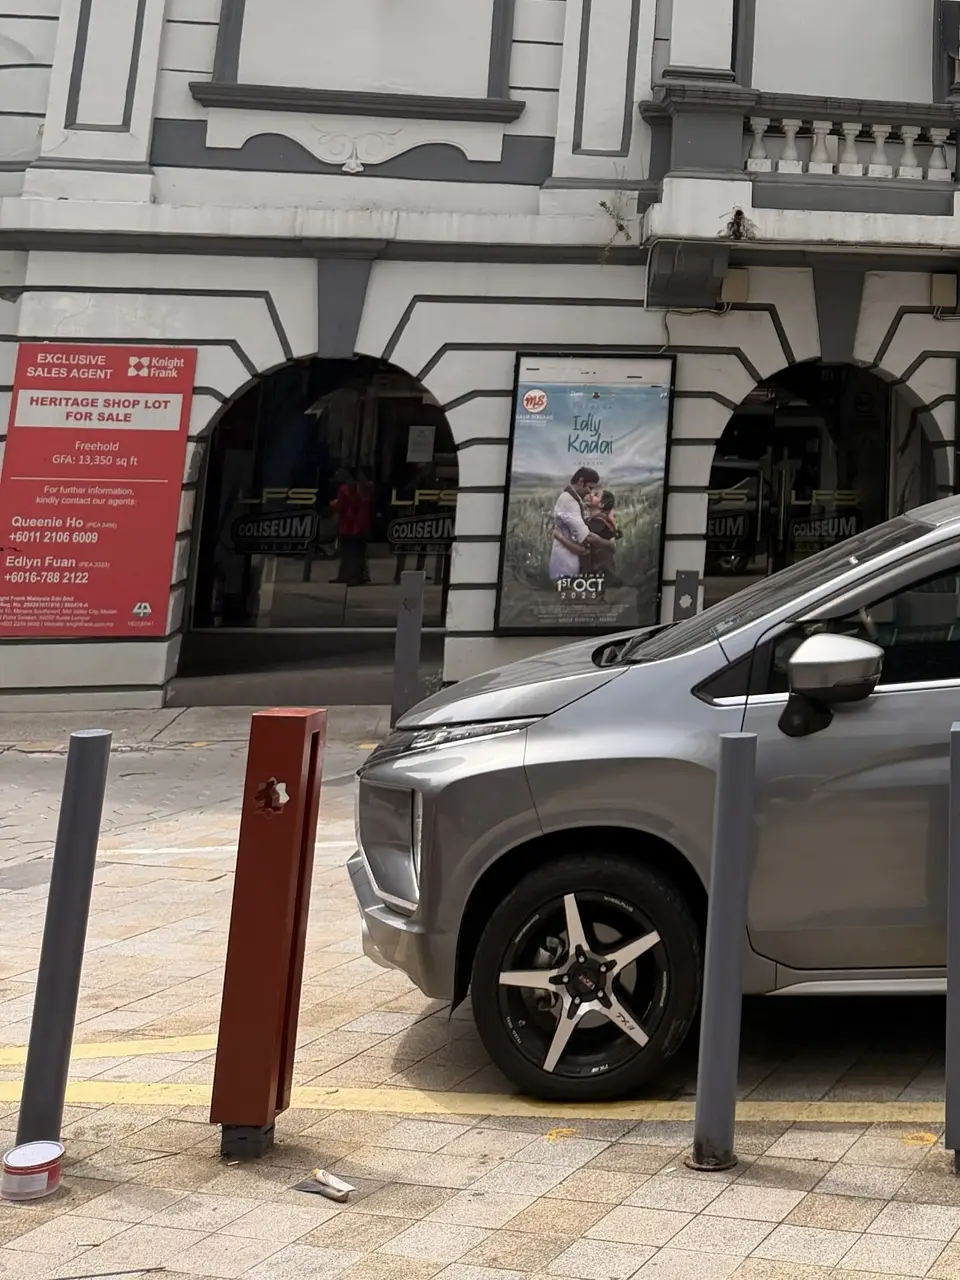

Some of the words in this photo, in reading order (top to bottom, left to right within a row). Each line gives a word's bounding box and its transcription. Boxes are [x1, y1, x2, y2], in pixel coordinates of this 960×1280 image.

[37, 353, 107, 366] EXCLUSIVE
[151, 356, 185, 369] Knight
[27, 367, 68, 379] SALES
[70, 368, 114, 380] AGENT
[150, 368, 178, 378] Frank
[29, 396, 99, 408] HERITAGE
[103, 398, 141, 409] SHOP
[144, 399, 170, 410] LOT
[65, 411, 93, 422] FOR
[97, 412, 133, 423] SALE
[572, 412, 601, 437] Idly
[75, 440, 120, 452] Freehold
[567, 432, 614, 455] Kadai
[52, 454, 77, 465] GFA:
[79, 454, 113, 466] 13,350
[116, 457, 128, 468] sq
[128, 456, 139, 466] ft
[44, 486, 59, 494] For
[60, 486, 86, 494] further
[36, 496, 60, 505] kindly
[61, 497, 91, 505] contact
[791, 489, 860, 506] LFS
[11, 516, 63, 528] Queenie
[66, 517, 84, 528] Ho
[238, 515, 313, 538] COLISEUM
[793, 516, 857, 537] COLISEUM
[9, 531, 41, 543] +6011
[43, 531, 70, 543] 2106
[72, 532, 99, 543] 6009
[6, 556, 41, 569] Edlyn
[44, 556, 76, 568] Fuan
[4, 572, 60, 583] +6016-788
[62, 572, 89, 583] 2122
[573, 578, 605, 592] OCT
